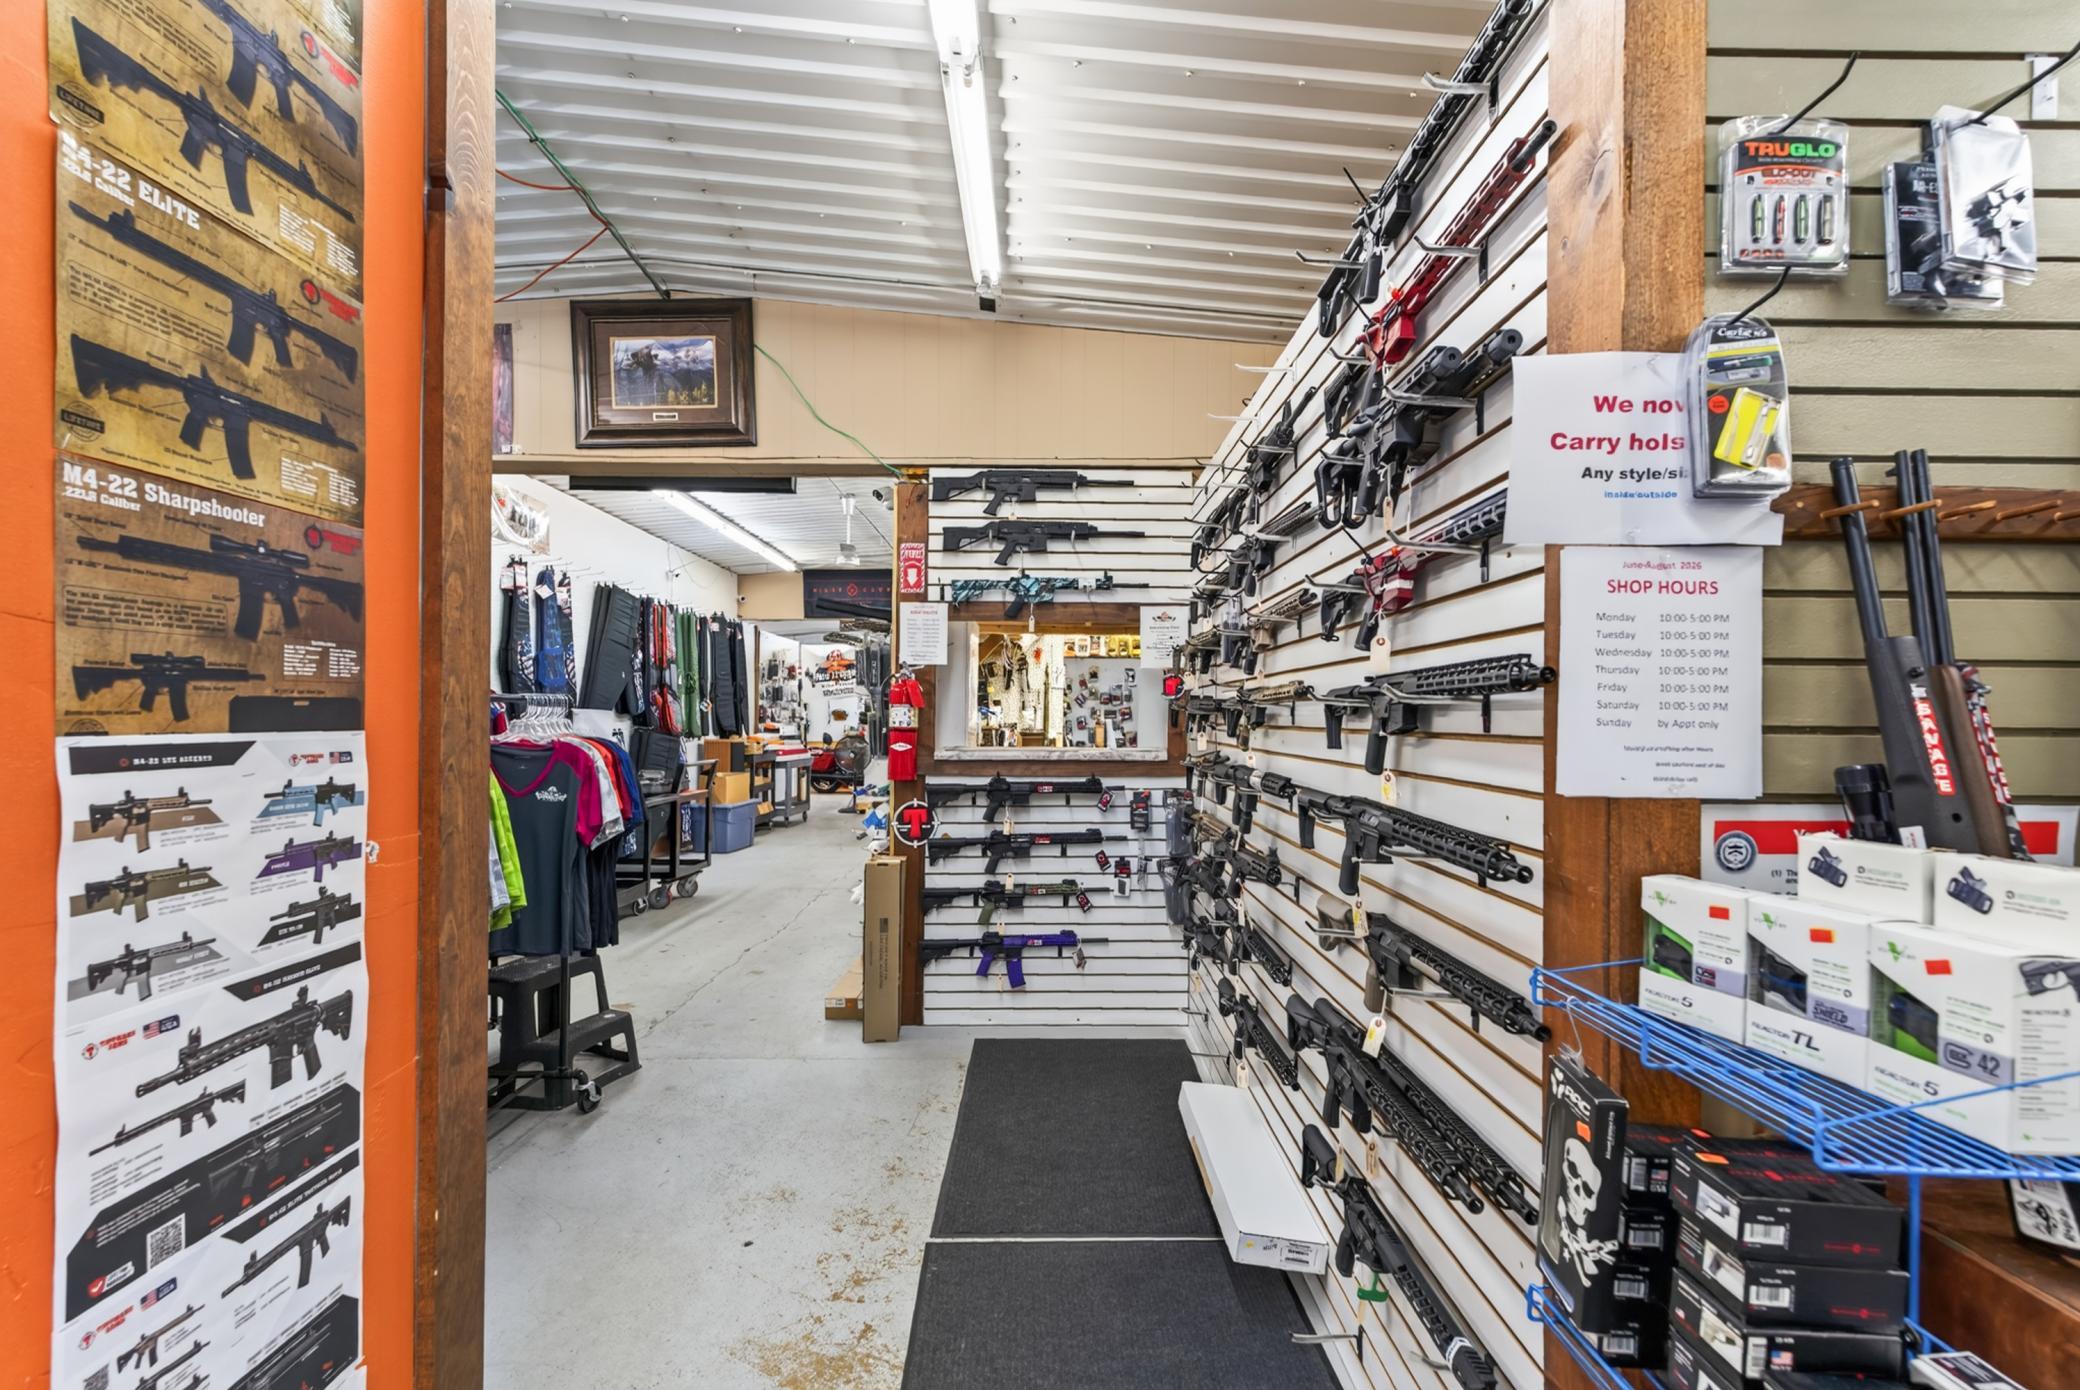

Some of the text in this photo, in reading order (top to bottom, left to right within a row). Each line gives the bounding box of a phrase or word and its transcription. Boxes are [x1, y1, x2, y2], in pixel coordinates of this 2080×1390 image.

[1745, 142, 1836, 158] TRUGLO
[138, 180, 200, 230] ELITE
[1593, 395, 1633, 413] We
[1550, 432, 1685, 455] Carry hols
[1581, 467, 1613, 482] Any
[63, 462, 138, 499] M4-22
[144, 484, 266, 527] Sharpshooter
[1607, 579, 1719, 595] SHOP HOURS
[1596, 612, 1636, 623] Monday
[1713, 614, 1730, 623] PM
[1596, 630, 1636, 641] Tuesday
[1713, 632, 1729, 640] PM
[1595, 648, 1652, 658] Wednesday
[1714, 649, 1730, 658] PM
[1595, 665, 1640, 675] Thursday
[1712, 666, 1728, 675] PM
[1597, 682, 1628, 692] Friday
[1713, 684, 1729, 693] PM
[1596, 700, 1640, 711] Saturday
[1712, 702, 1729, 711] PM
[1596, 717, 1719, 730] Sunday by Appt only
[1914, 702, 1954, 793] SAVAGE
[1681, 996, 1694, 1009] 5
[1791, 1030, 1820, 1052] TL
[1977, 1053, 2001, 1078] 42
[1923, 1080, 1941, 1097] 5
